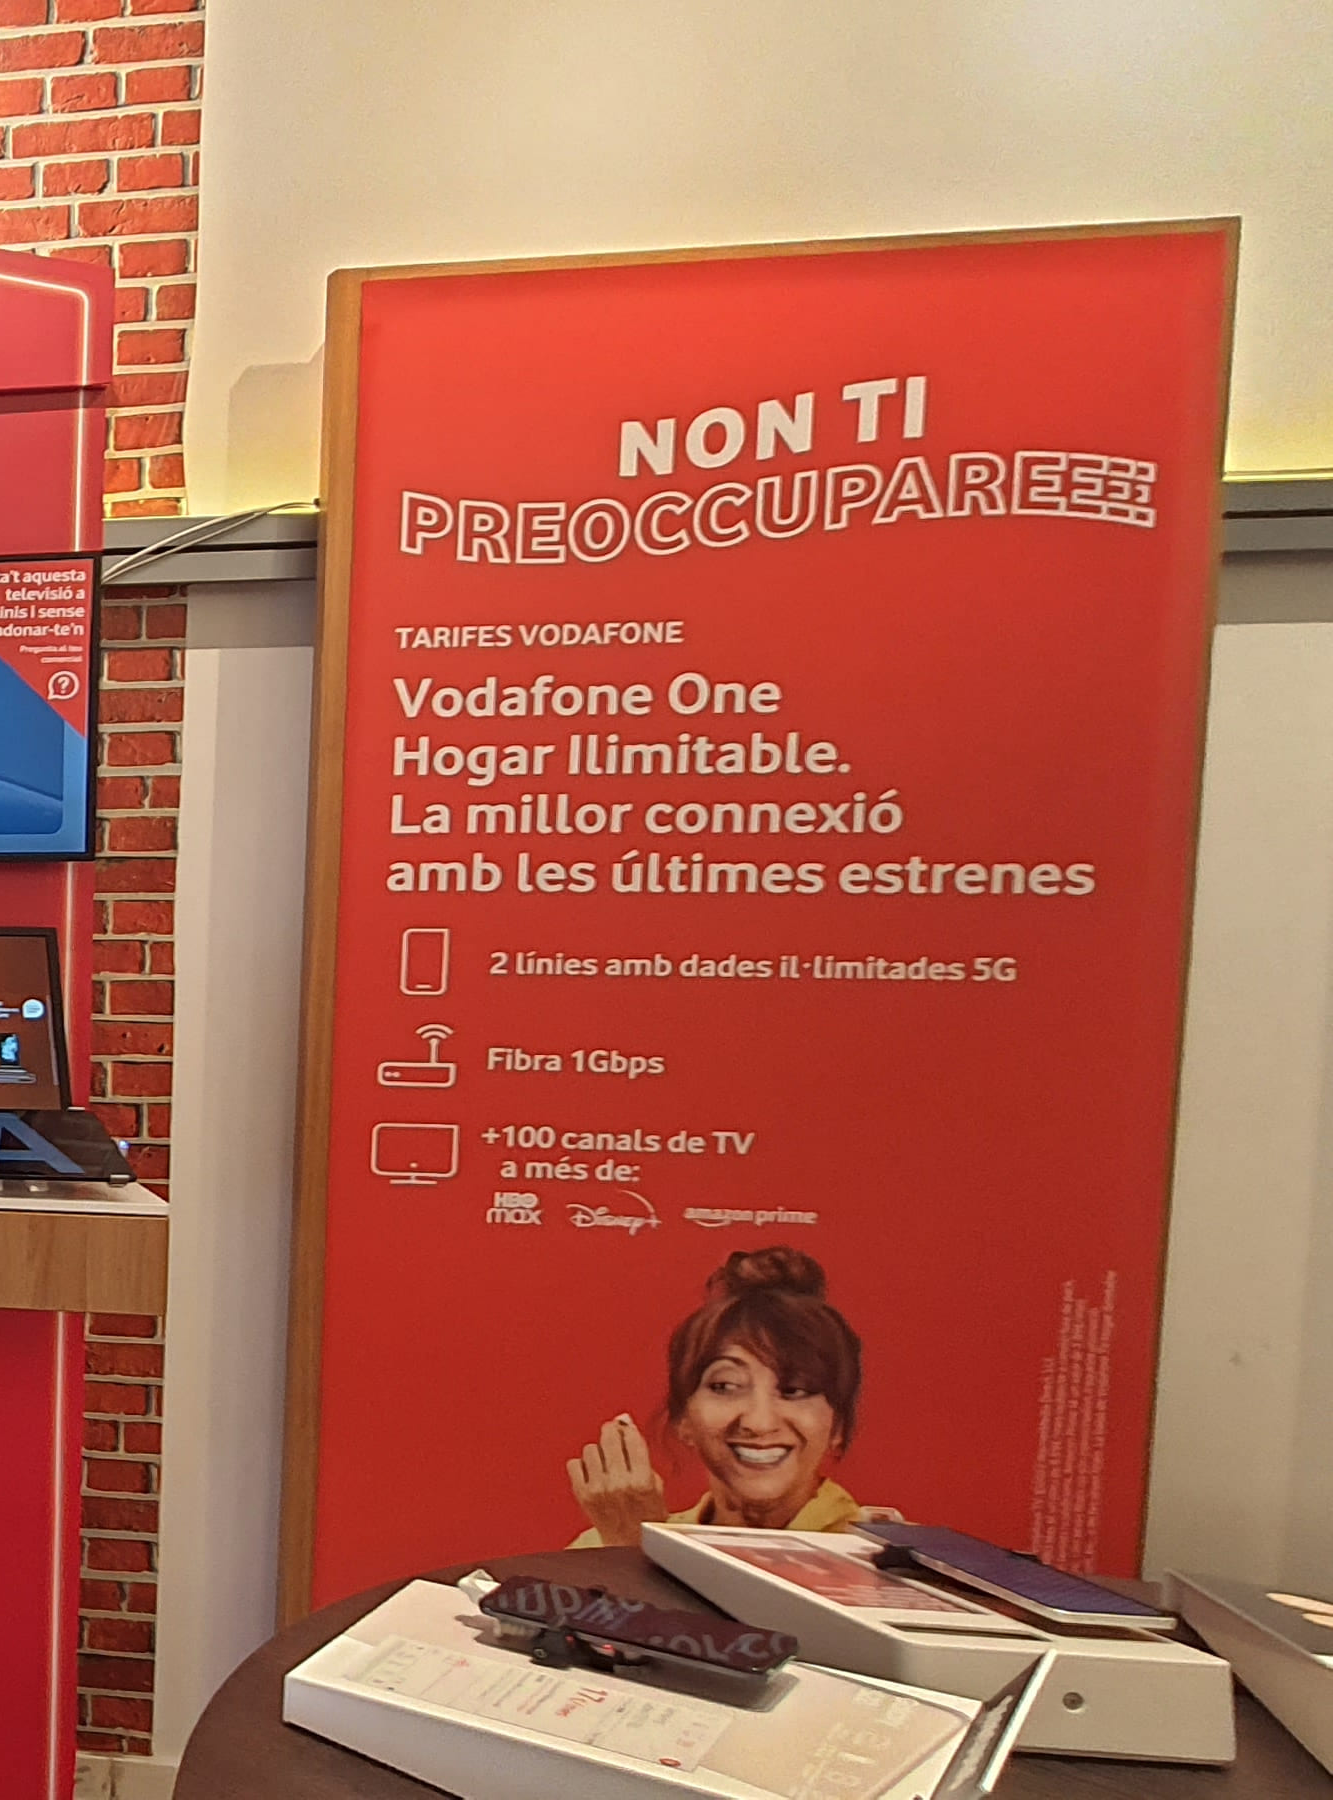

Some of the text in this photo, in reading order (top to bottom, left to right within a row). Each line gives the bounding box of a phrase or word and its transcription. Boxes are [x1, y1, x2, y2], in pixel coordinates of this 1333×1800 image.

[618, 376, 926, 477] NON TI
[22, 569, 87, 586] aquesta
[5, 585, 86, 601] televisió a
[37, 606, 86, 619] sense
[394, 621, 684, 649] TARIFES VODAFONE
[393, 672, 782, 718] Vodafone One
[393, 732, 851, 787] Hogar Ilimitable.
[391, 789, 903, 834] La millor connexió
[386, 849, 1095, 896] amb les últimes estrenes
[489, 951, 508, 975] 2
[515, 951, 598, 976] línies
[604, 953, 673, 977] amb
[679, 953, 773, 978] dades
[972, 957, 1016, 982] 5G
[487, 1047, 665, 1079] Fibra 1Gbps
[481, 1125, 755, 1155] +100 canals de TV
[499, 1156, 640, 1182] a més de:
[493, 1192, 538, 1208] HBO
[485, 1208, 543, 1225] max
[754, 1207, 819, 1226] prime
